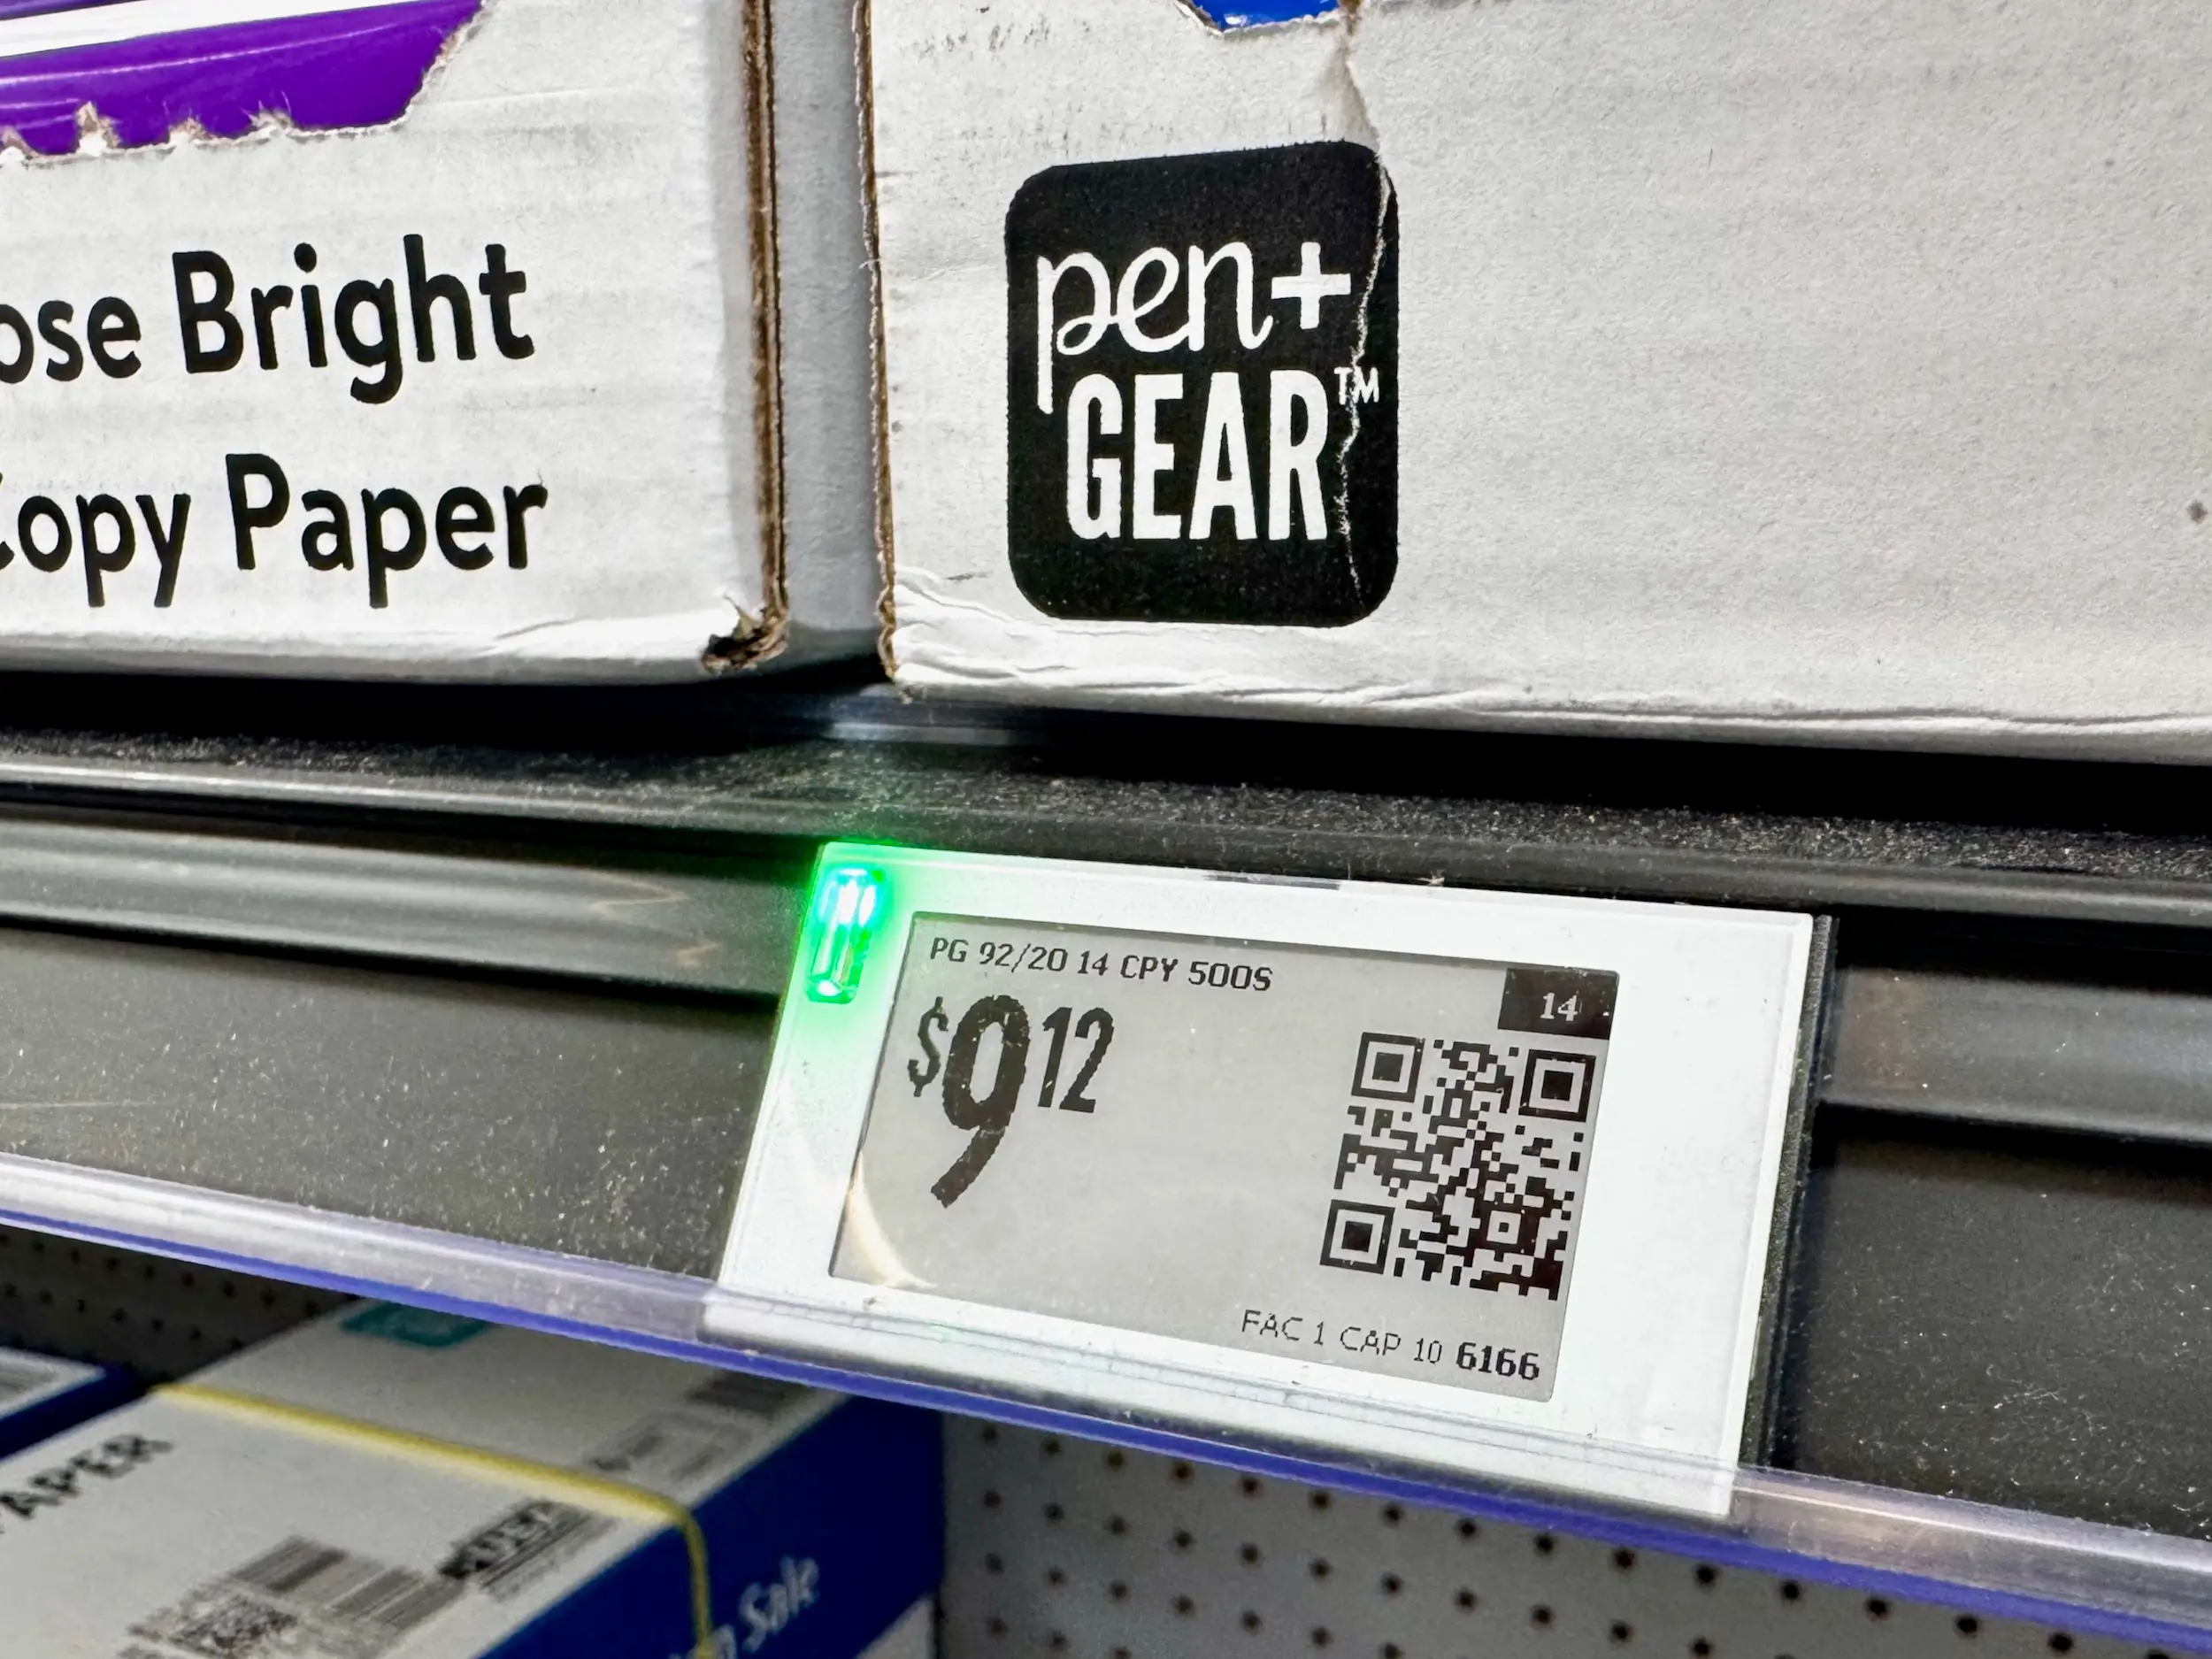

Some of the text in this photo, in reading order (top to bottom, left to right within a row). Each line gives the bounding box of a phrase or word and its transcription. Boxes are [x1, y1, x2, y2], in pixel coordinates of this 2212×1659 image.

[172, 234, 534, 404] Bright
[0, 453, 548, 609] opy Paper
[929, 937, 1274, 992] PG 92/20 14 CPY 500S
[1540, 992, 1578, 1022] 14
[1240, 1309, 1540, 1381] FAC 1 CAP 10 6166
